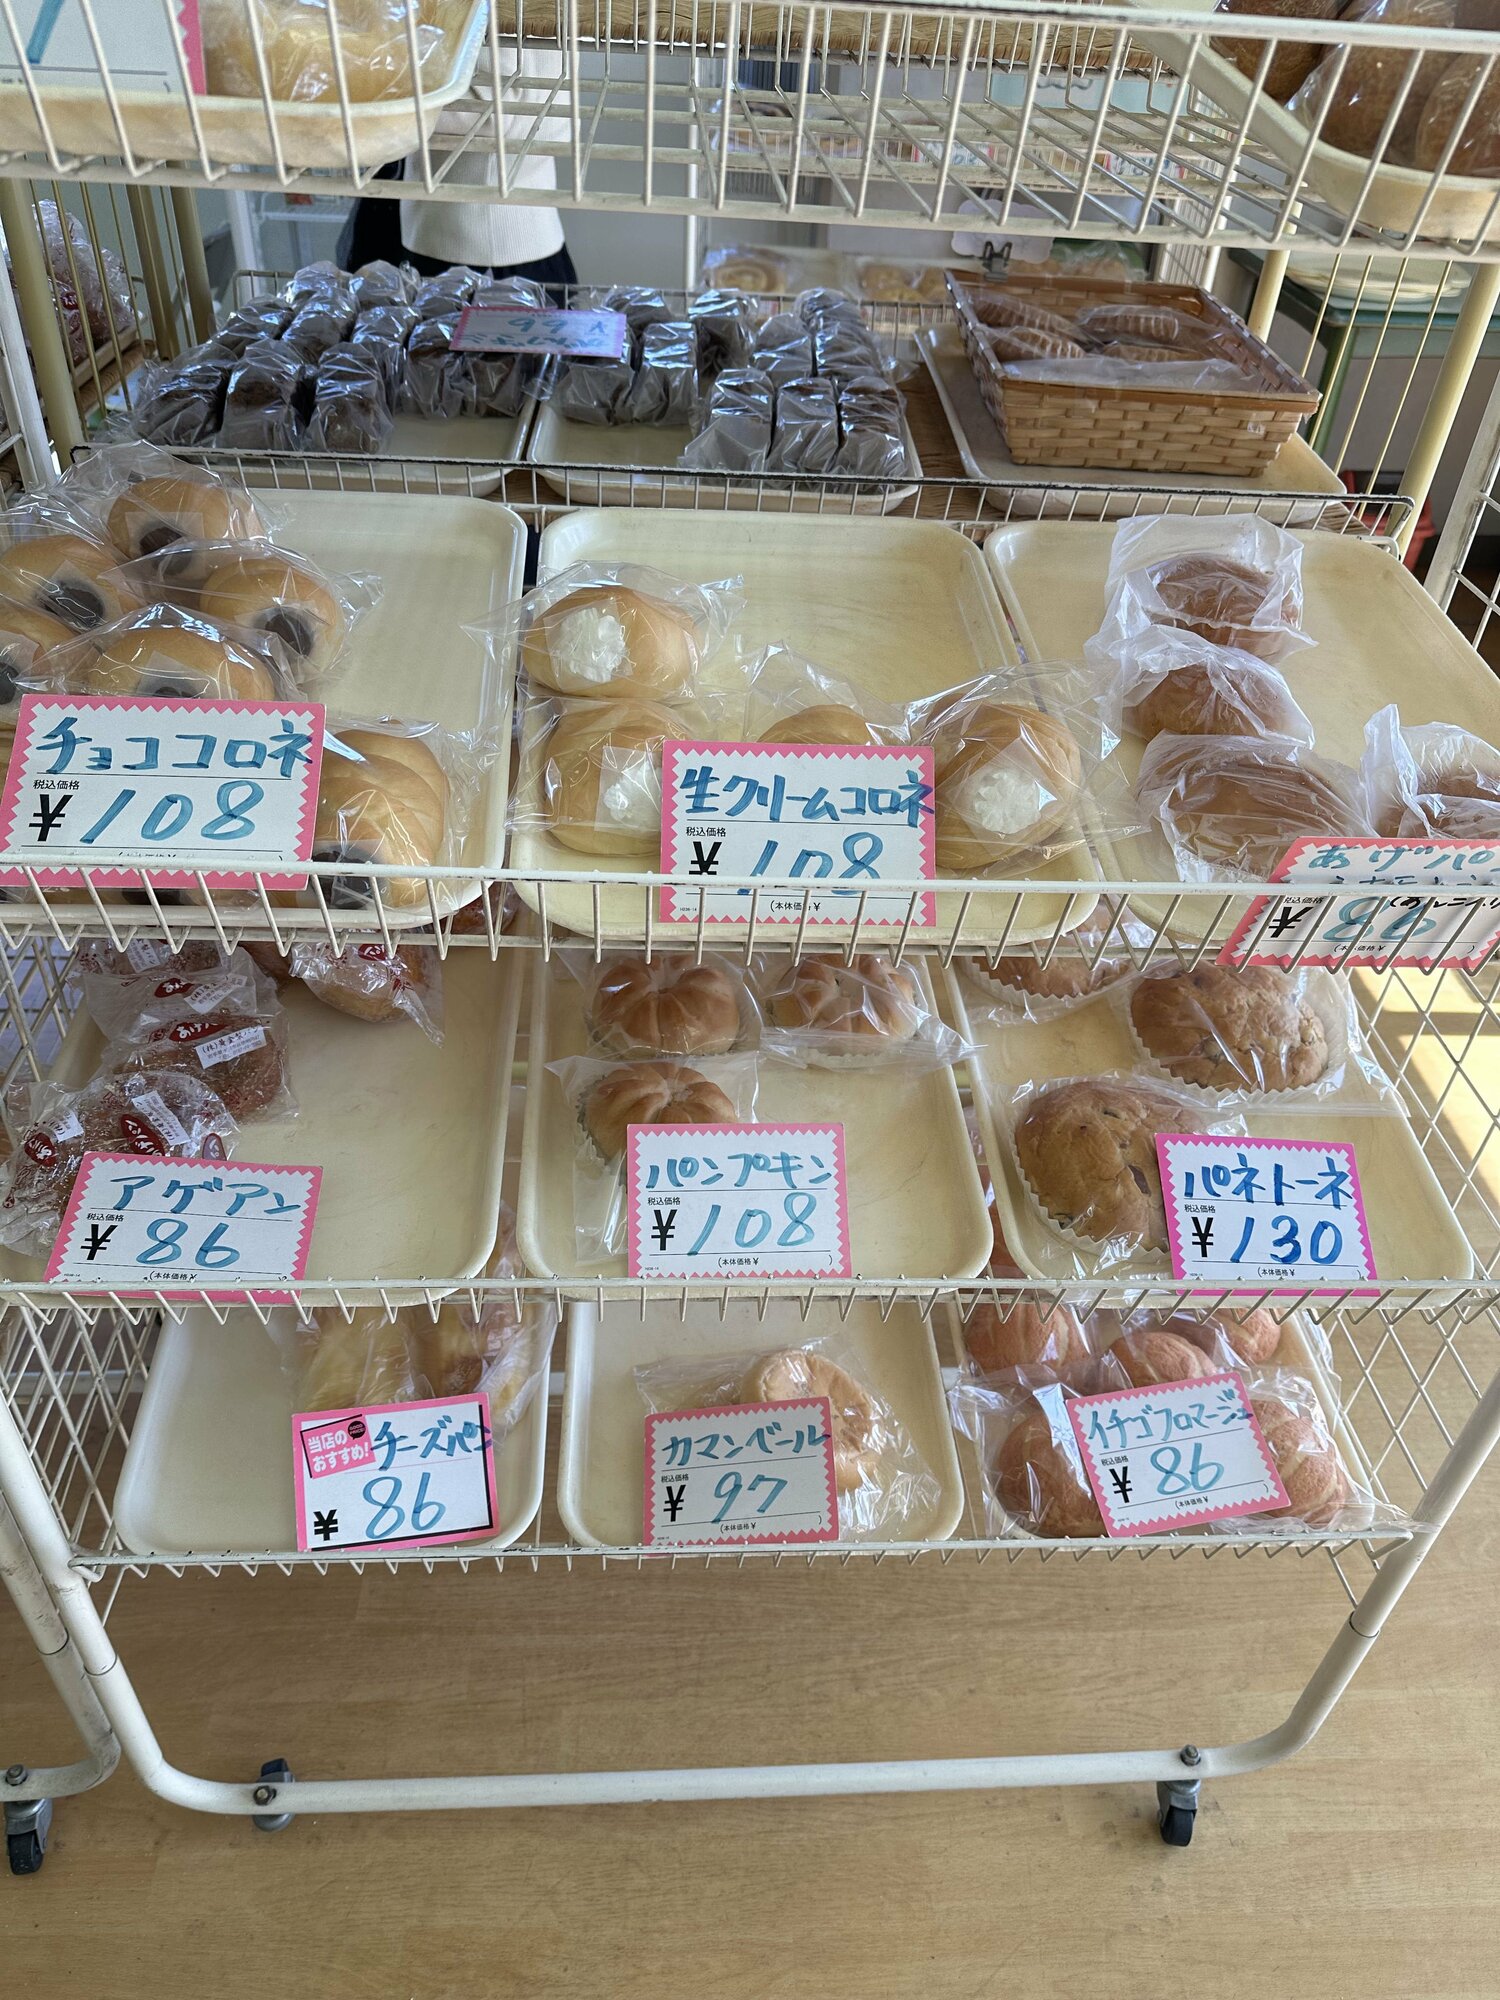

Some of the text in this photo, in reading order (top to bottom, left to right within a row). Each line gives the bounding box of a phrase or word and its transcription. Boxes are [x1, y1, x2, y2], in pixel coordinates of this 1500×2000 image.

[36, 716, 313, 778] チョココロネ
[33, 779, 80, 790] 税込価格
[680, 766, 934, 828] 生クリームコロネ
[29, 780, 264, 844] ¥ 108
[686, 826, 726, 837] 税込価格
[737, 831, 883, 895] 108
[1308, 845, 1500, 873] あげパ
[1268, 896, 1436, 941] ¥ 86
[645, 1151, 832, 1189] パンプキン
[1184, 1152, 1353, 1210] パネトーネ
[86, 1213, 124, 1222] 税込価格
[110, 1175, 301, 1216] アゲアン
[647, 1197, 681, 1206] 税込価格
[1184, 1204, 1216, 1213] 税込価格
[80, 1218, 240, 1268] ¥ 86
[651, 1192, 817, 1256] ¥ 108
[1191, 1214, 1342, 1265] ¥ 130
[1088, 1388, 1253, 1449] イチゴフロマージュ
[308, 1429, 348, 1454] 当店の
[313, 1444, 369, 1473] おすすめ!
[370, 1414, 493, 1471] チーズパン
[662, 1421, 831, 1466] カマンベール
[1101, 1456, 1129, 1467] 税込価格
[661, 1473, 689, 1483] 税込価格
[1109, 1443, 1224, 1503] ¥ 86
[313, 1472, 446, 1541] ¥ 86
[663, 1471, 788, 1524] ¥ 97
